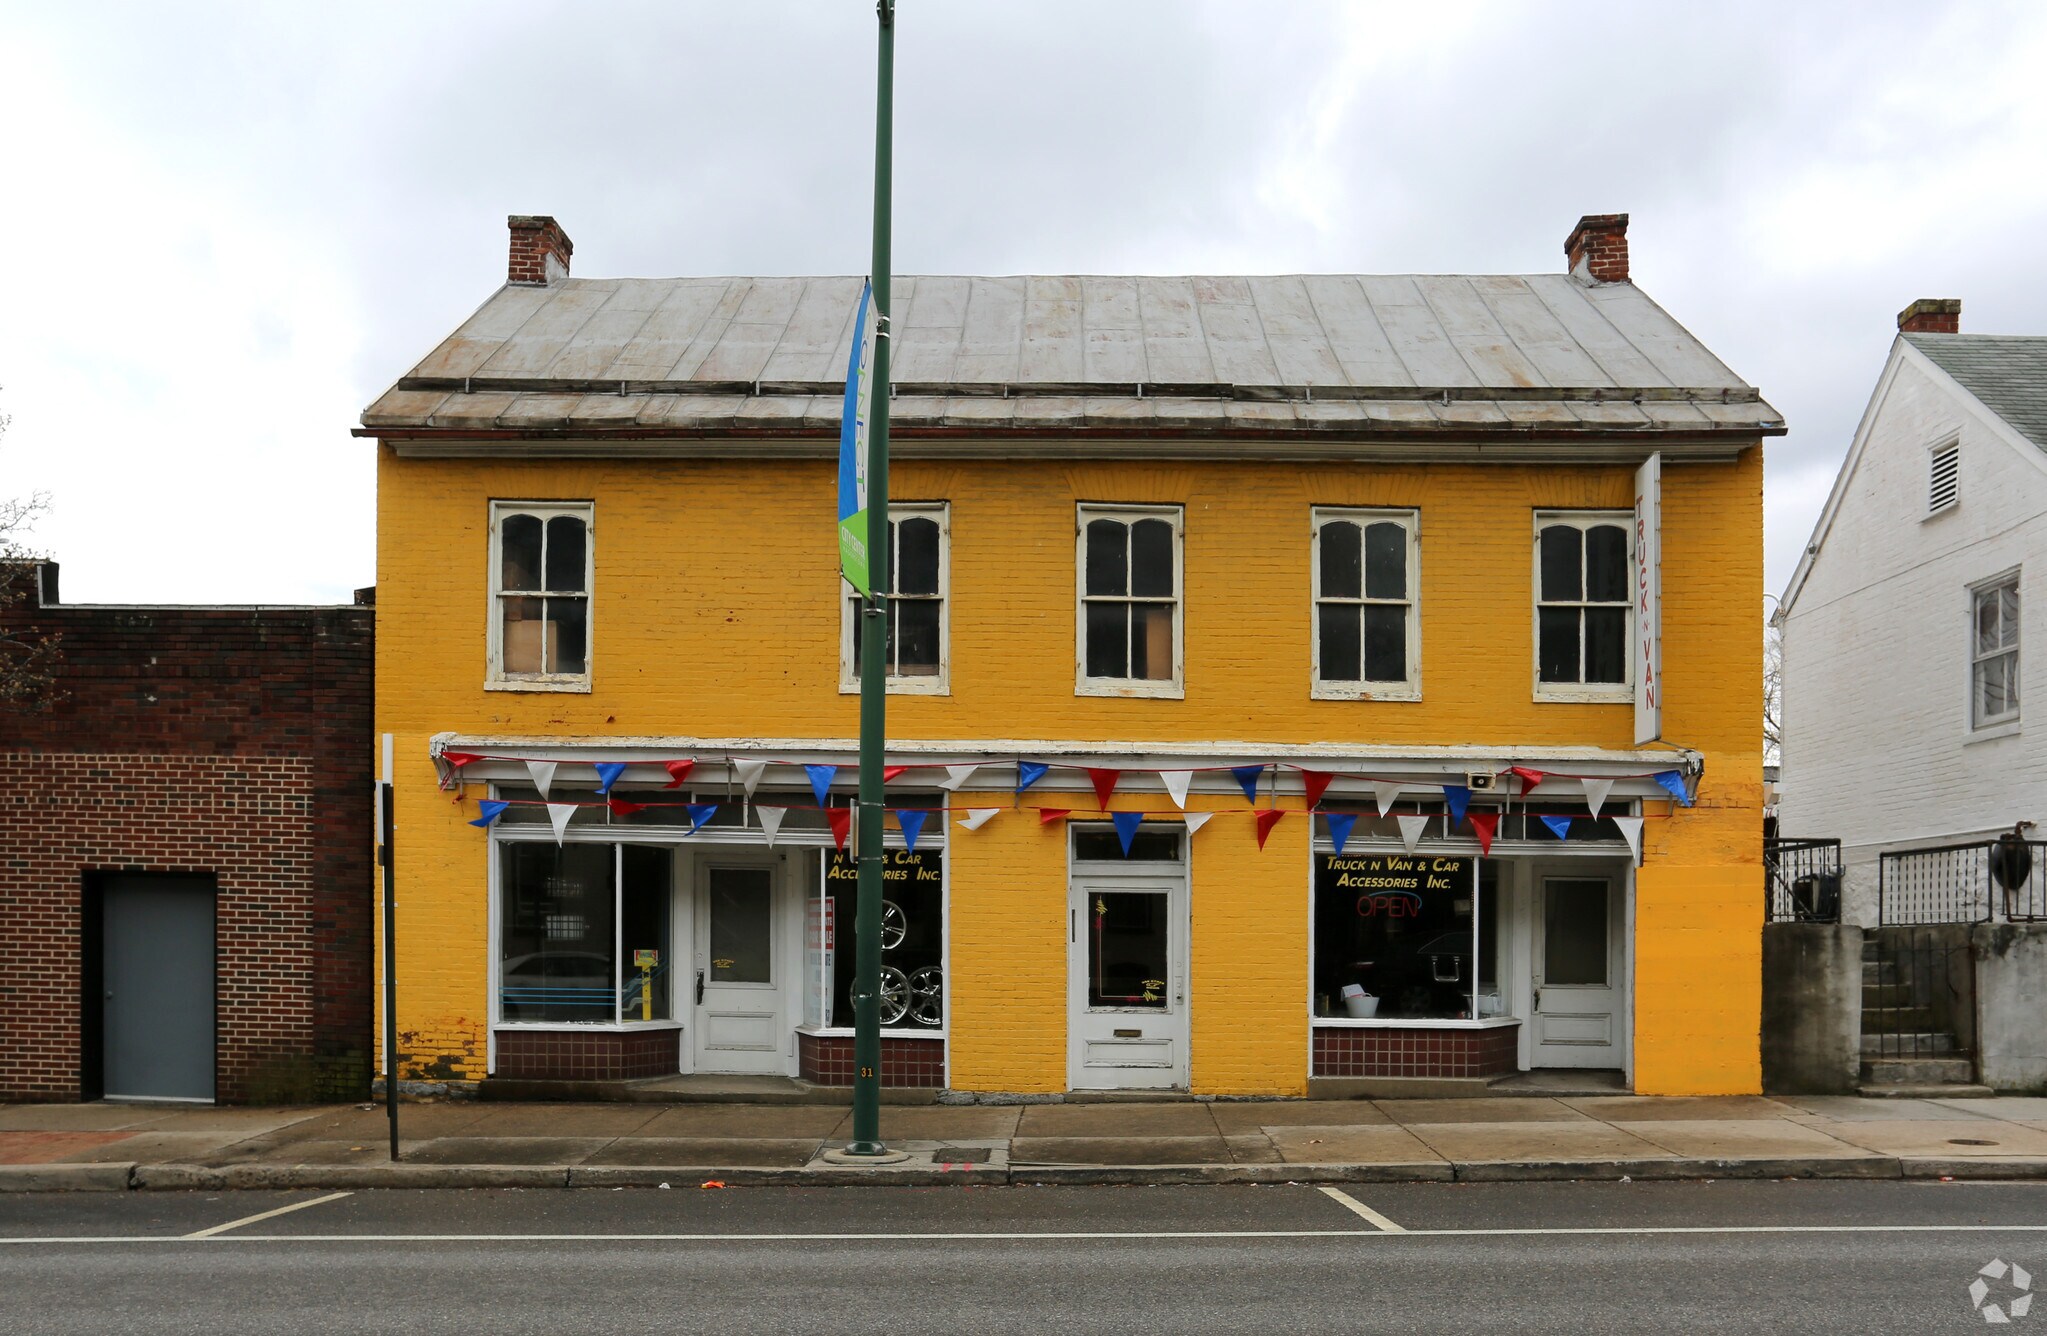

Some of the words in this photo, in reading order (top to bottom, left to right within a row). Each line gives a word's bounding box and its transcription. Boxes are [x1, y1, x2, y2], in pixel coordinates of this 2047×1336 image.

[855, 311, 871, 493] CONNECT
[1635, 494, 1648, 615] TRUCK
[1643, 636, 1655, 712] VAN
[895, 850, 922, 865] CAR
[1327, 856, 1365, 871] TRUCK
[1371, 861, 1381, 871] N
[1387, 856, 1413, 871] VAN
[1417, 861, 1427, 871] &
[1432, 857, 1460, 872] CAR
[916, 866, 942, 881] INC.
[1336, 872, 1418, 888] ACCESSORIES
[1426, 874, 1452, 889] INC.
[1356, 895, 1419, 918] OPEN
[861, 1067, 873, 1078] 31
